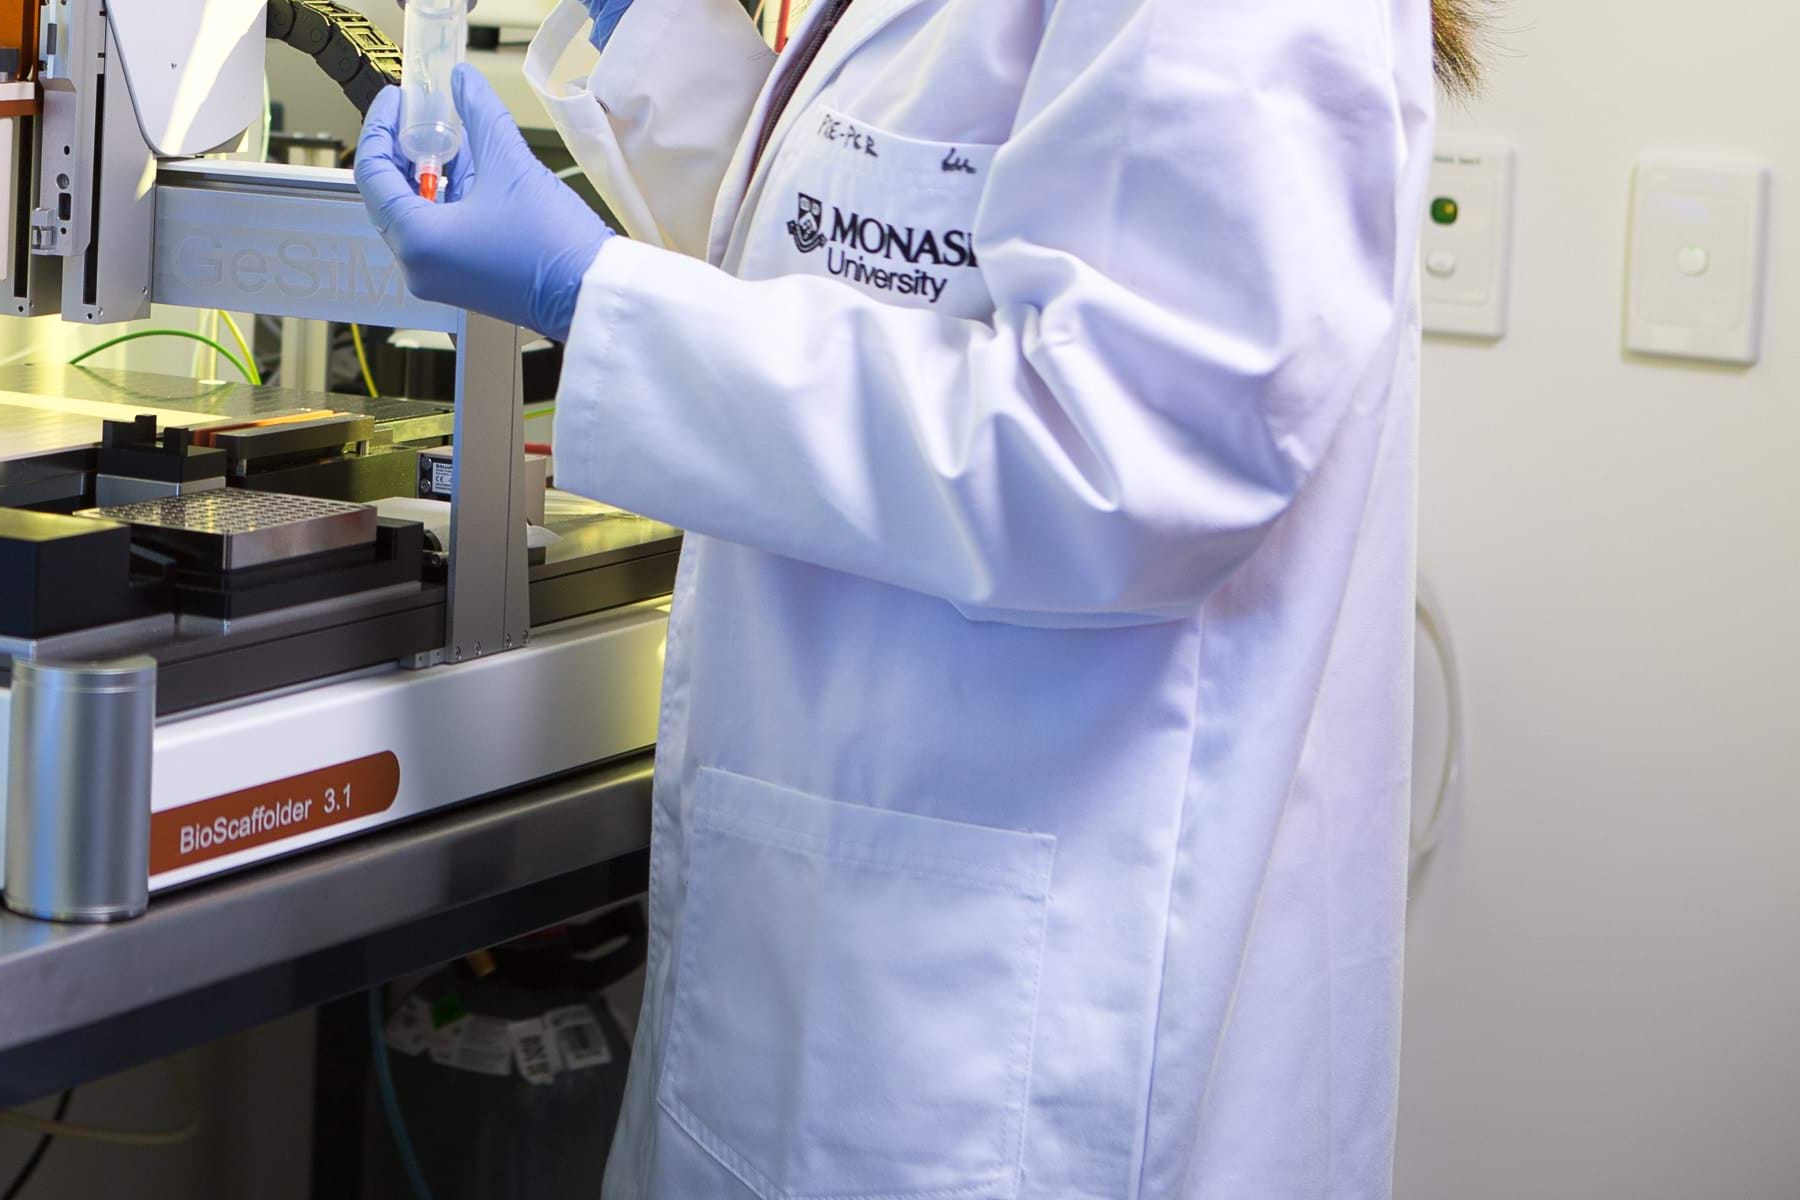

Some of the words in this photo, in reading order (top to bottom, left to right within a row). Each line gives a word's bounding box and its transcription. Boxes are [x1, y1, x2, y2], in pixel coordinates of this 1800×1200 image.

[827, 246, 948, 303] University
[179, 798, 313, 855] BioScaffolder
[323, 783, 352, 814] 3.1
